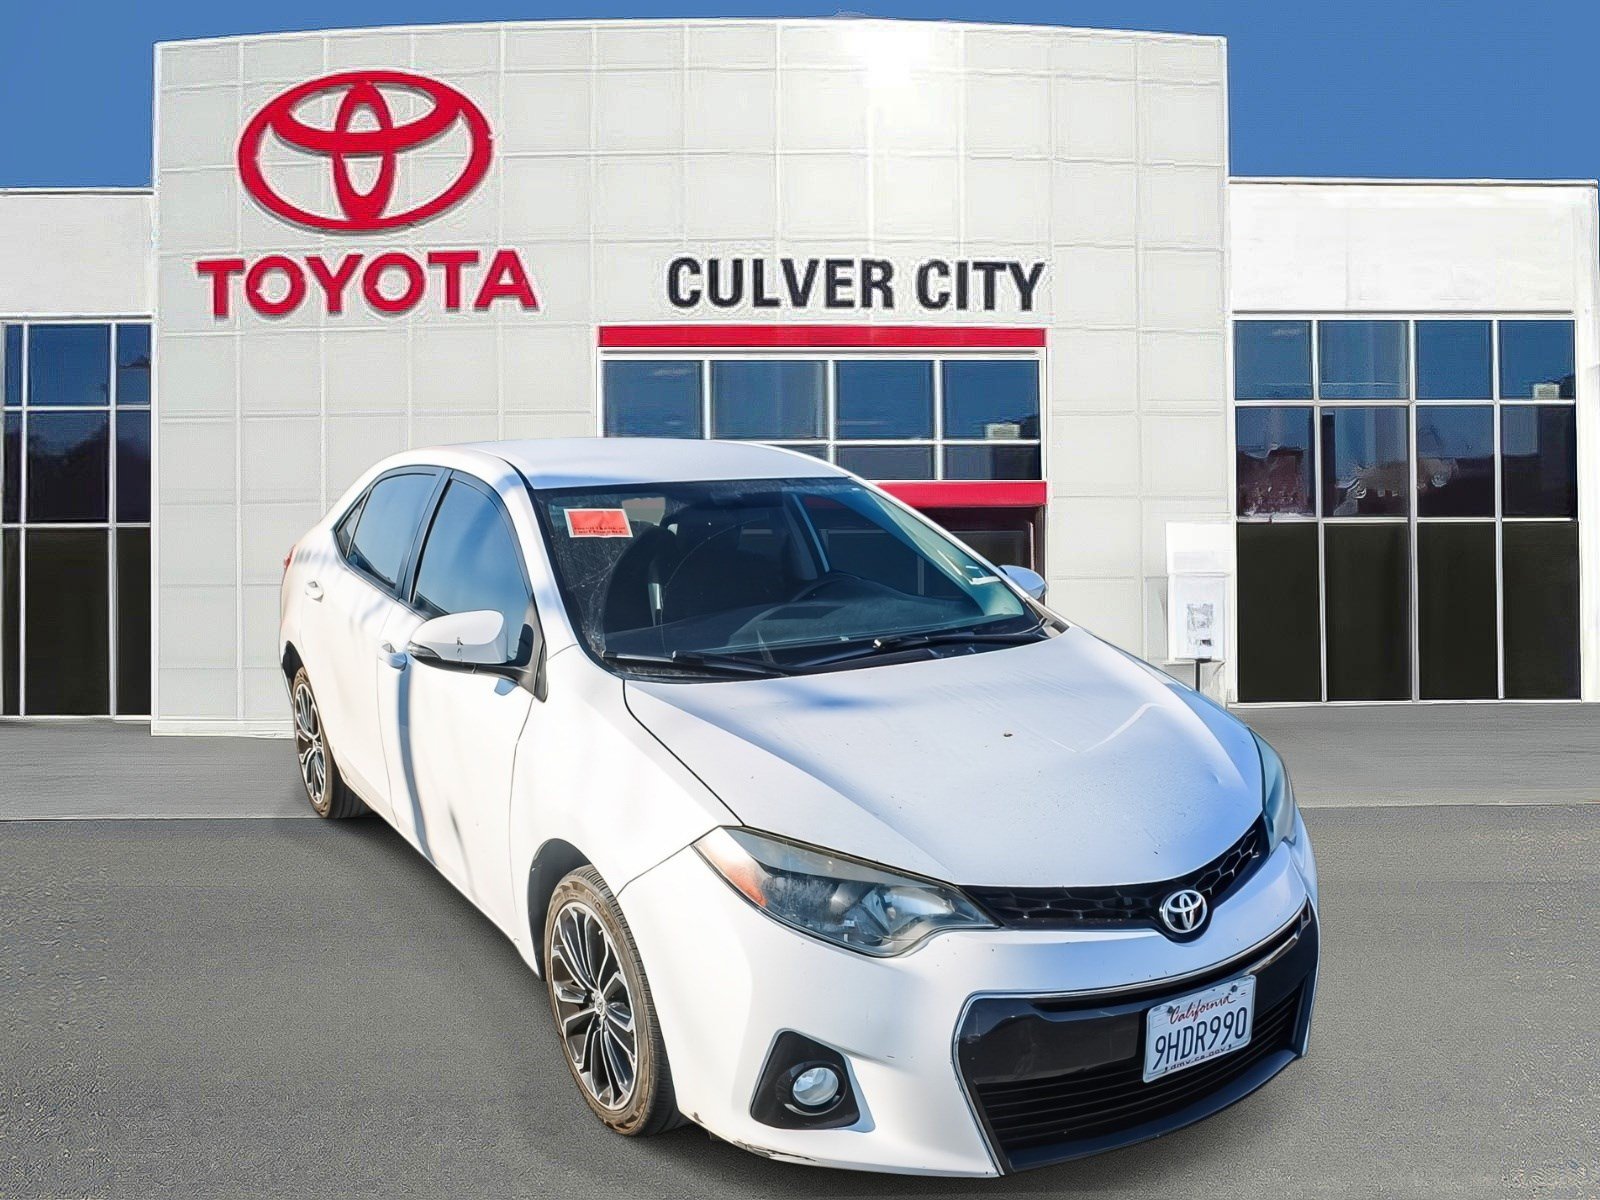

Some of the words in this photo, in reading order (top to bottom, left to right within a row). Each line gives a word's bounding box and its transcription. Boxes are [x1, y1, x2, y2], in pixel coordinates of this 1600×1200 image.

[195, 248, 538, 319] TOYOTA
[667, 256, 895, 309] CULVER
[916, 258, 1046, 312] CITY
[1169, 992, 1236, 1024] California
[1152, 1006, 1248, 1071] 9HDR990
